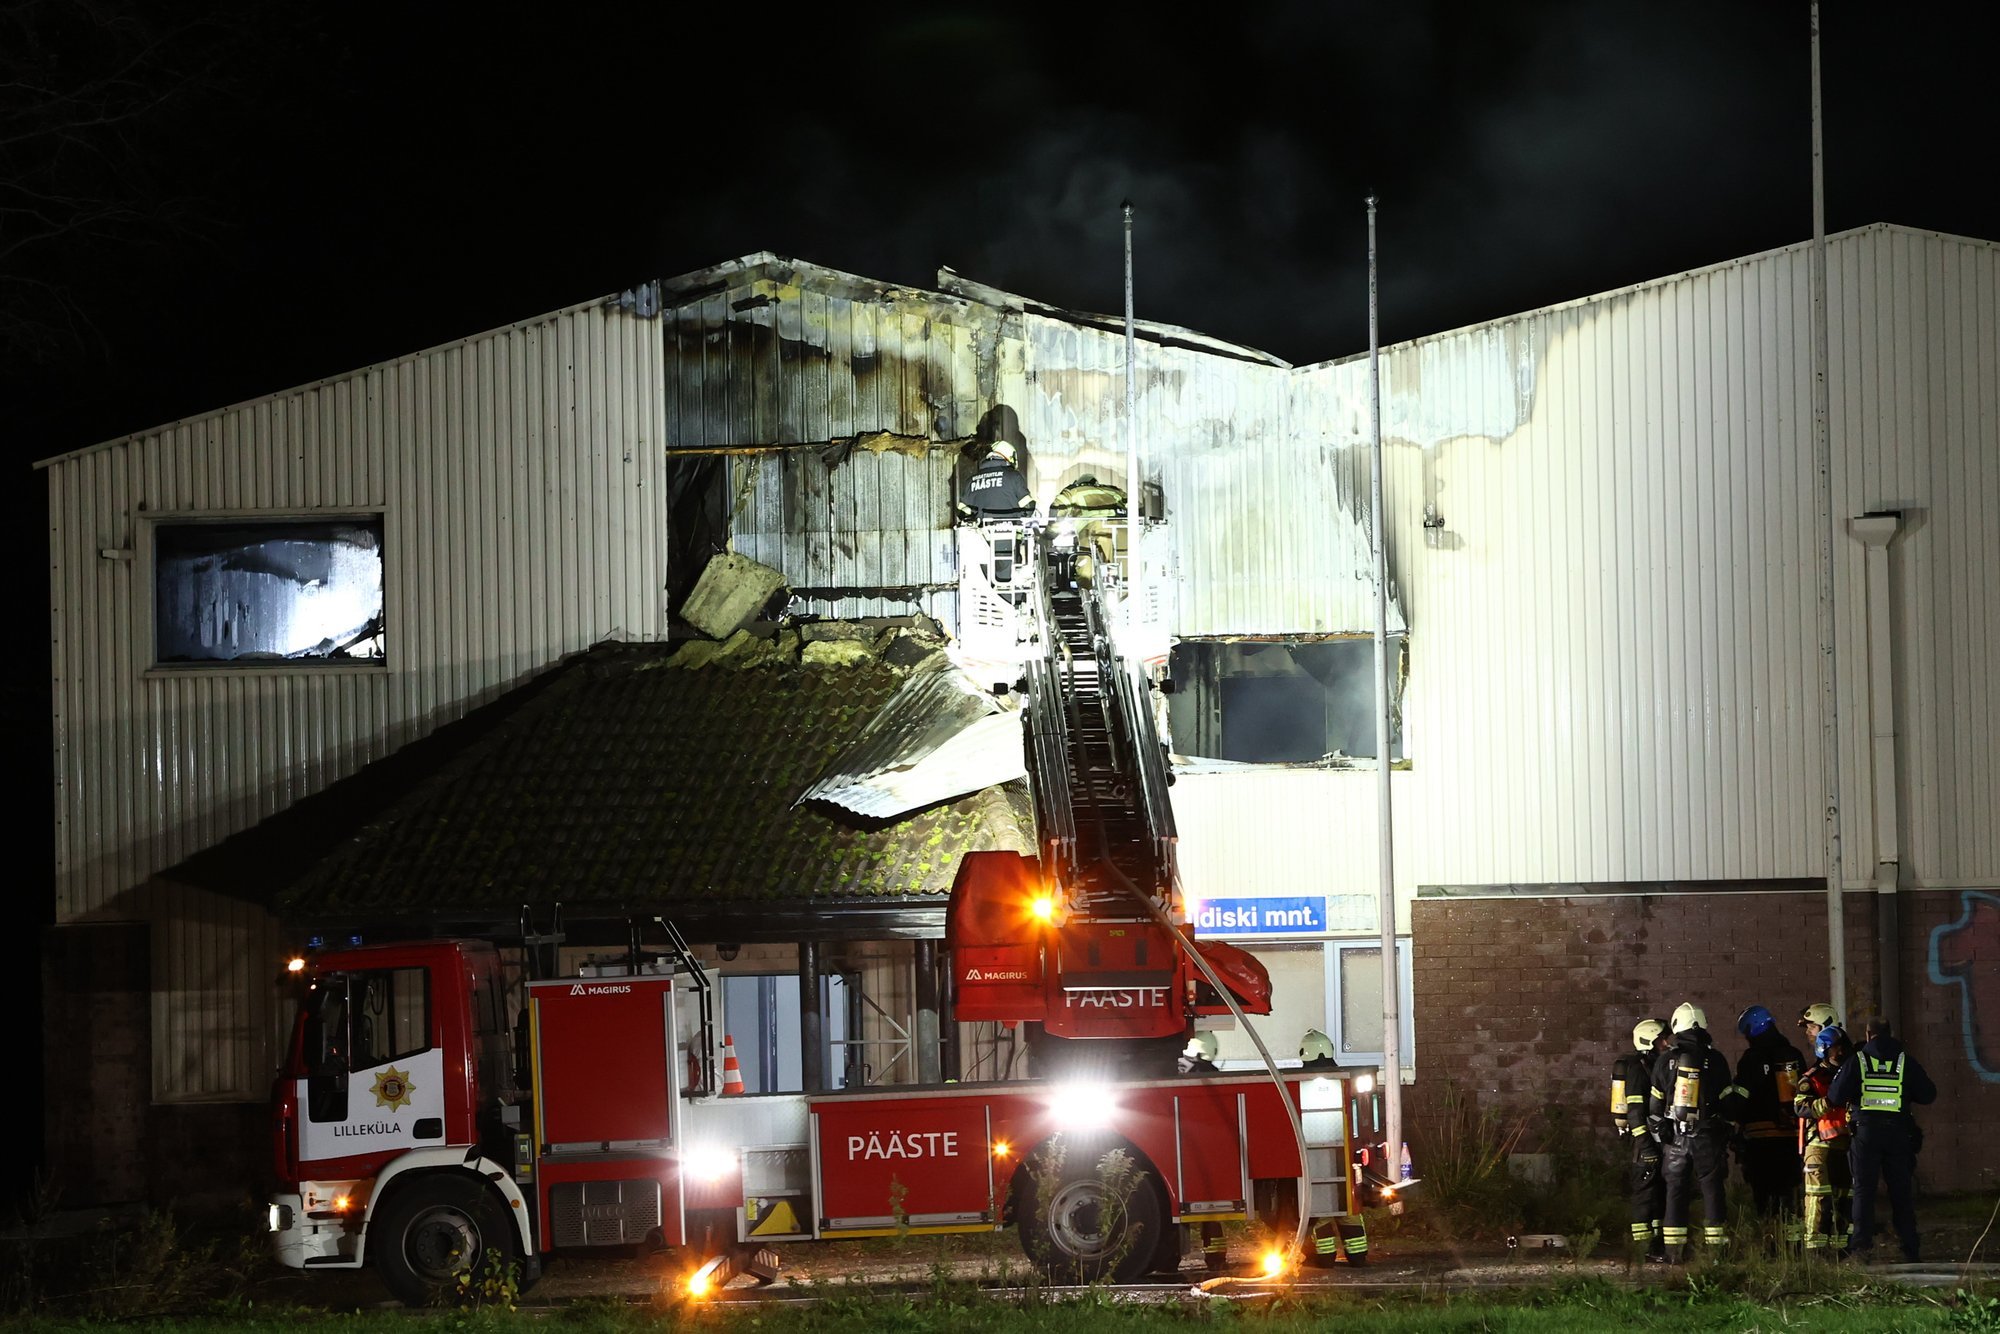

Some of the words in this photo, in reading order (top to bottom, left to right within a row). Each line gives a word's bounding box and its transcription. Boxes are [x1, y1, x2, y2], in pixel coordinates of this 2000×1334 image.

[1186, 906, 1258, 928] ldiski
[1265, 905, 1319, 927] mnt.
[984, 971, 1028, 980] MAGIRUS
[588, 985, 631, 995] MAGIRUS
[334, 1121, 402, 1137] LILLEKÜLA
[847, 1130, 958, 1160] PÄÄSTE
